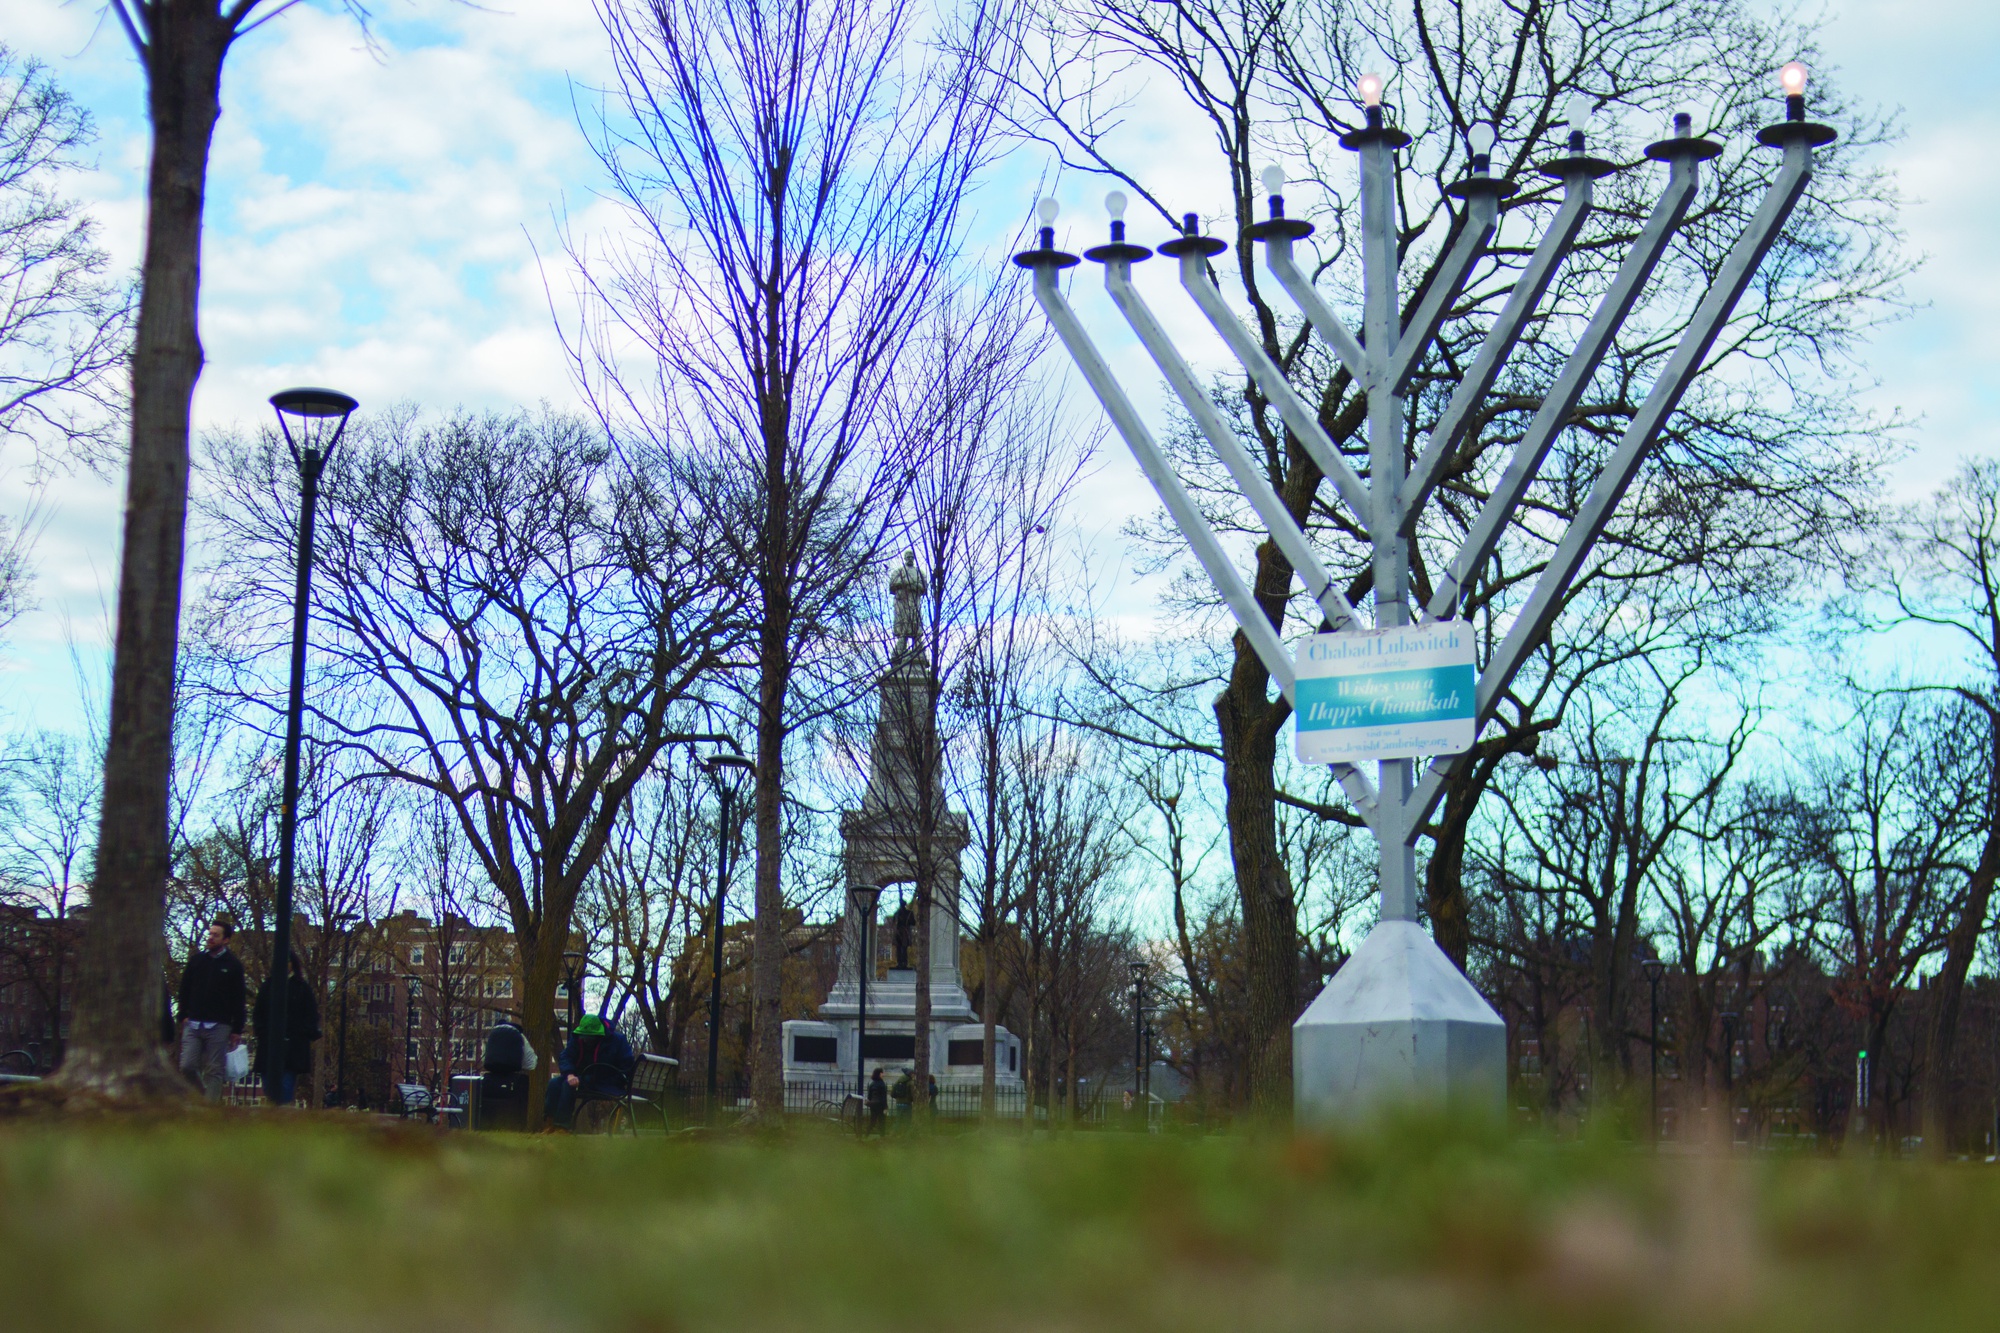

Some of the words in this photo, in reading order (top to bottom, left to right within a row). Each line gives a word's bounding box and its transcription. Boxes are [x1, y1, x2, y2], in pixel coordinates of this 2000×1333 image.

[1309, 638, 1371, 661] Chabad
[1377, 630, 1459, 655] Lubavitch
[1338, 679, 1389, 696] Wishes
[1394, 680, 1421, 694] you
[1423, 679, 1434, 689] a
[1308, 702, 1366, 726] Happy
[1369, 690, 1459, 715] Chanukah
